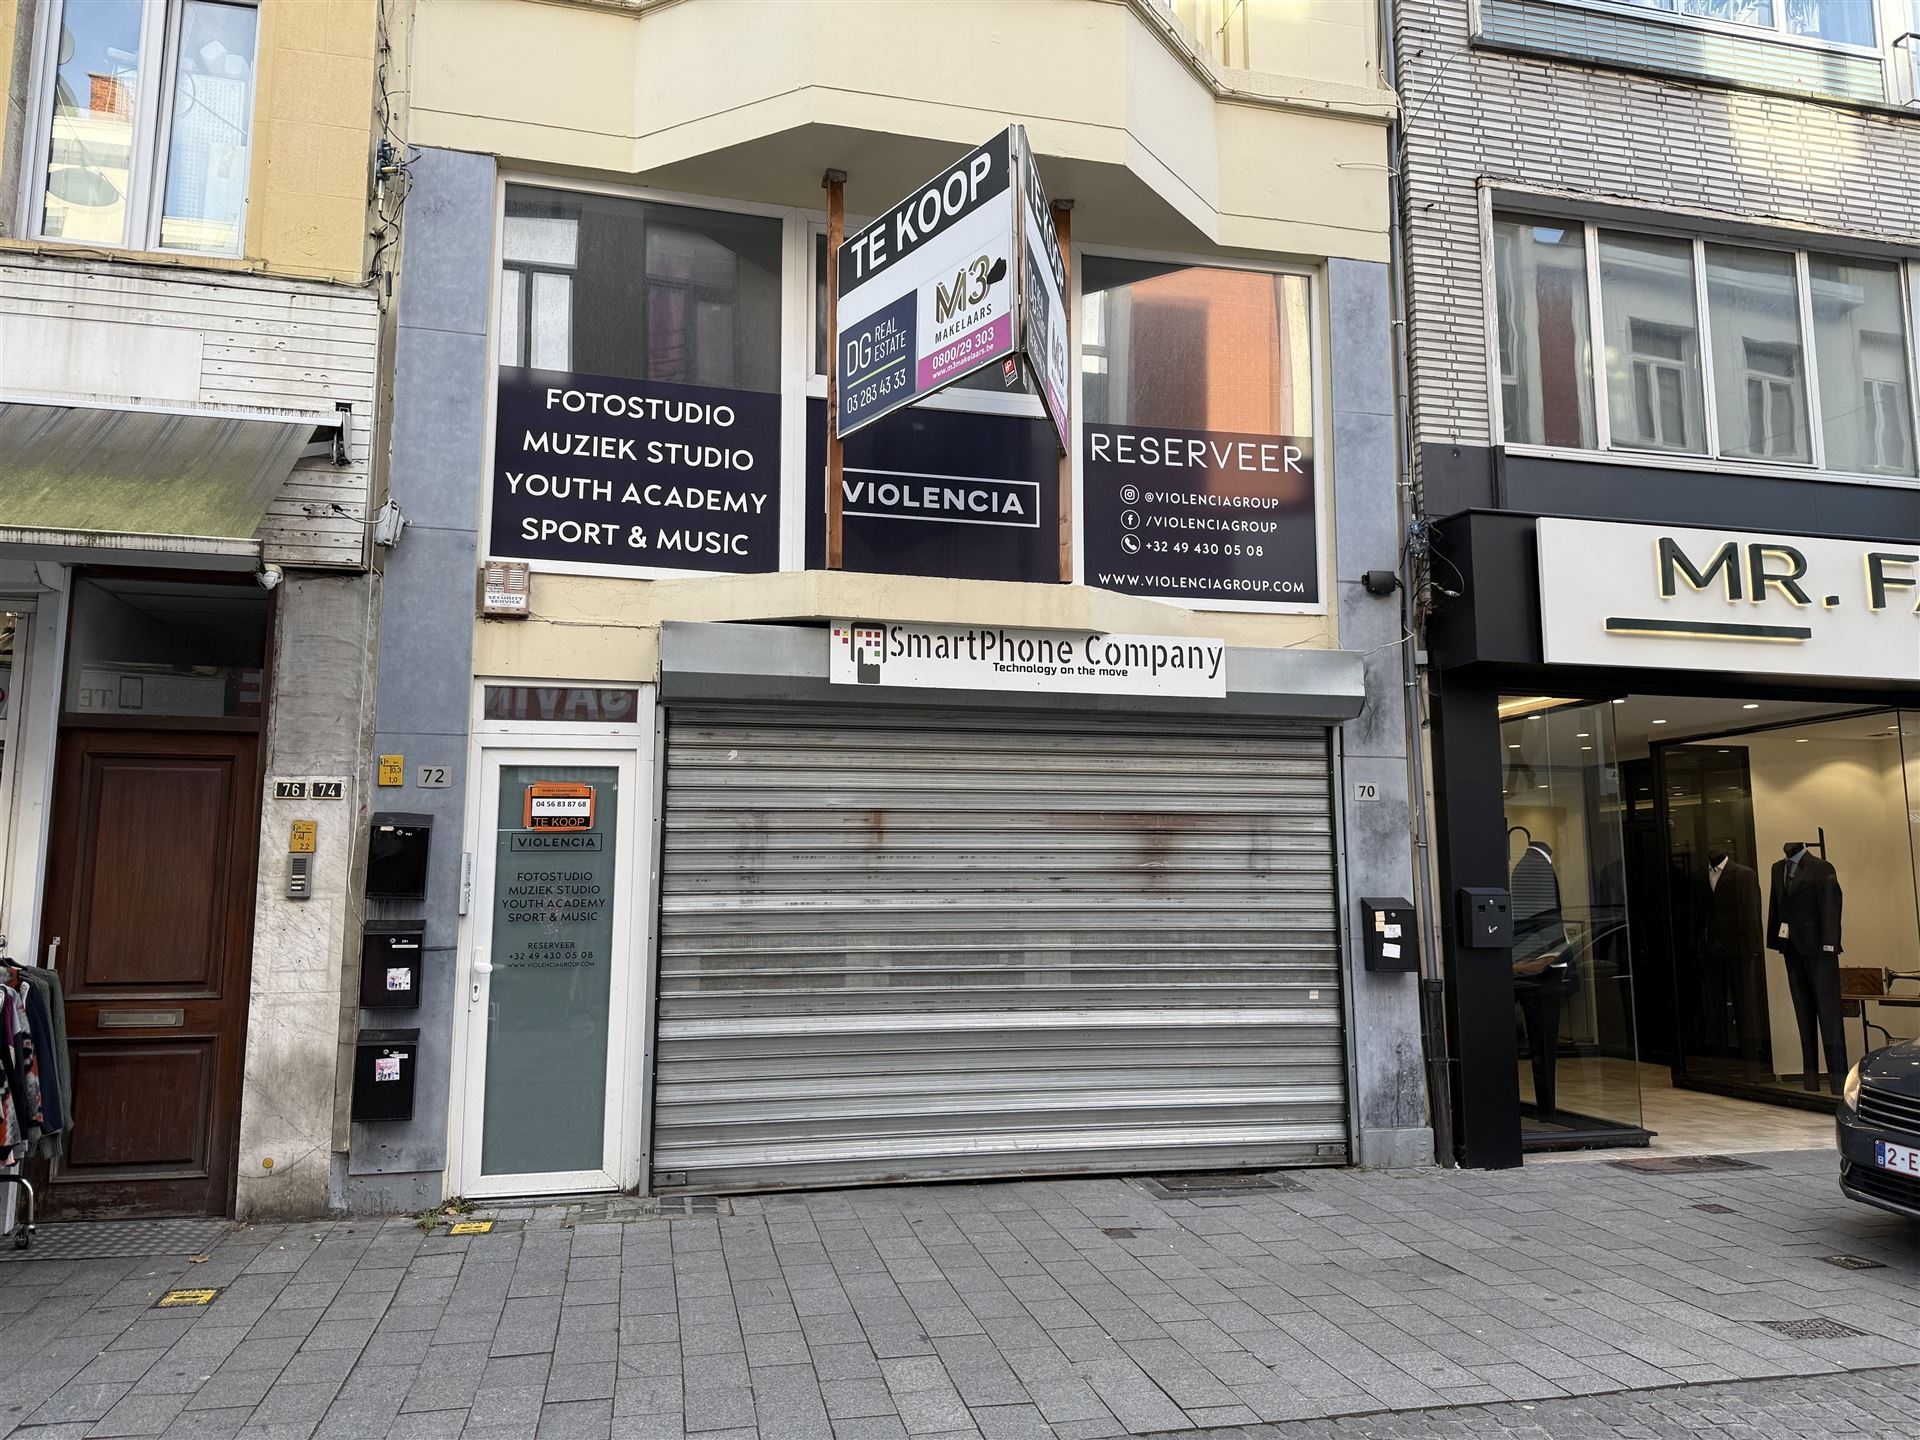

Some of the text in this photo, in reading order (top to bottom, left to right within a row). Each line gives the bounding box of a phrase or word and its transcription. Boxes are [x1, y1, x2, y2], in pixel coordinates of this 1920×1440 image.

[851, 152, 992, 279] TE KOOP
[935, 254, 991, 325] M3
[874, 317, 897, 342] REAL
[934, 303, 993, 344] MAKELAARS
[847, 332, 872, 378] DG
[874, 330, 907, 362] ESTATE
[932, 327, 995, 370] 0800/29 303
[932, 343, 994, 379] www.m3makelaars.be
[847, 368, 906, 414] 03 283 43 33
[546, 388, 735, 427] FOTOSTUDIO
[523, 430, 754, 471] MUZIEK STUDIO
[1091, 433, 1304, 474] RESERVEER
[505, 472, 767, 514] YOUTH ACADEMY
[843, 480, 1024, 515] VIOLENCIA
[1144, 491, 1279, 509] @VIOLENCIAGROUP
[1146, 516, 1278, 533] /VIOLENCIAGROUP
[521, 517, 749, 556] SPORT & MUSIC
[1146, 541, 1264, 557] +32 49 430 05 08
[1098, 573, 1305, 593] WWW.VIOLENCIAGROUP.COM
[1655, 536, 1920, 615] MR. F
[890, 626, 1223, 679] SmartPhone Company
[993, 662, 1129, 677] Technology on the move
[423, 769, 444, 784] 72
[282, 782, 301, 797] 76
[318, 783, 336, 797] 74
[1358, 785, 1375, 798] 70
[534, 817, 585, 827] TE KOOP
[518, 837, 596, 847] VIOLENCIA
[517, 872, 593, 881] FOTOSTUDIO
[508, 885, 601, 895] MUZIEK STUDIO
[502, 898, 606, 909] YOUTH ACADEMY
[508, 912, 598, 922] SPORT & MUSIC
[543, 952, 561, 960] 430
[581, 951, 594, 959] 08
[1878, 1155, 1884, 1165] B
